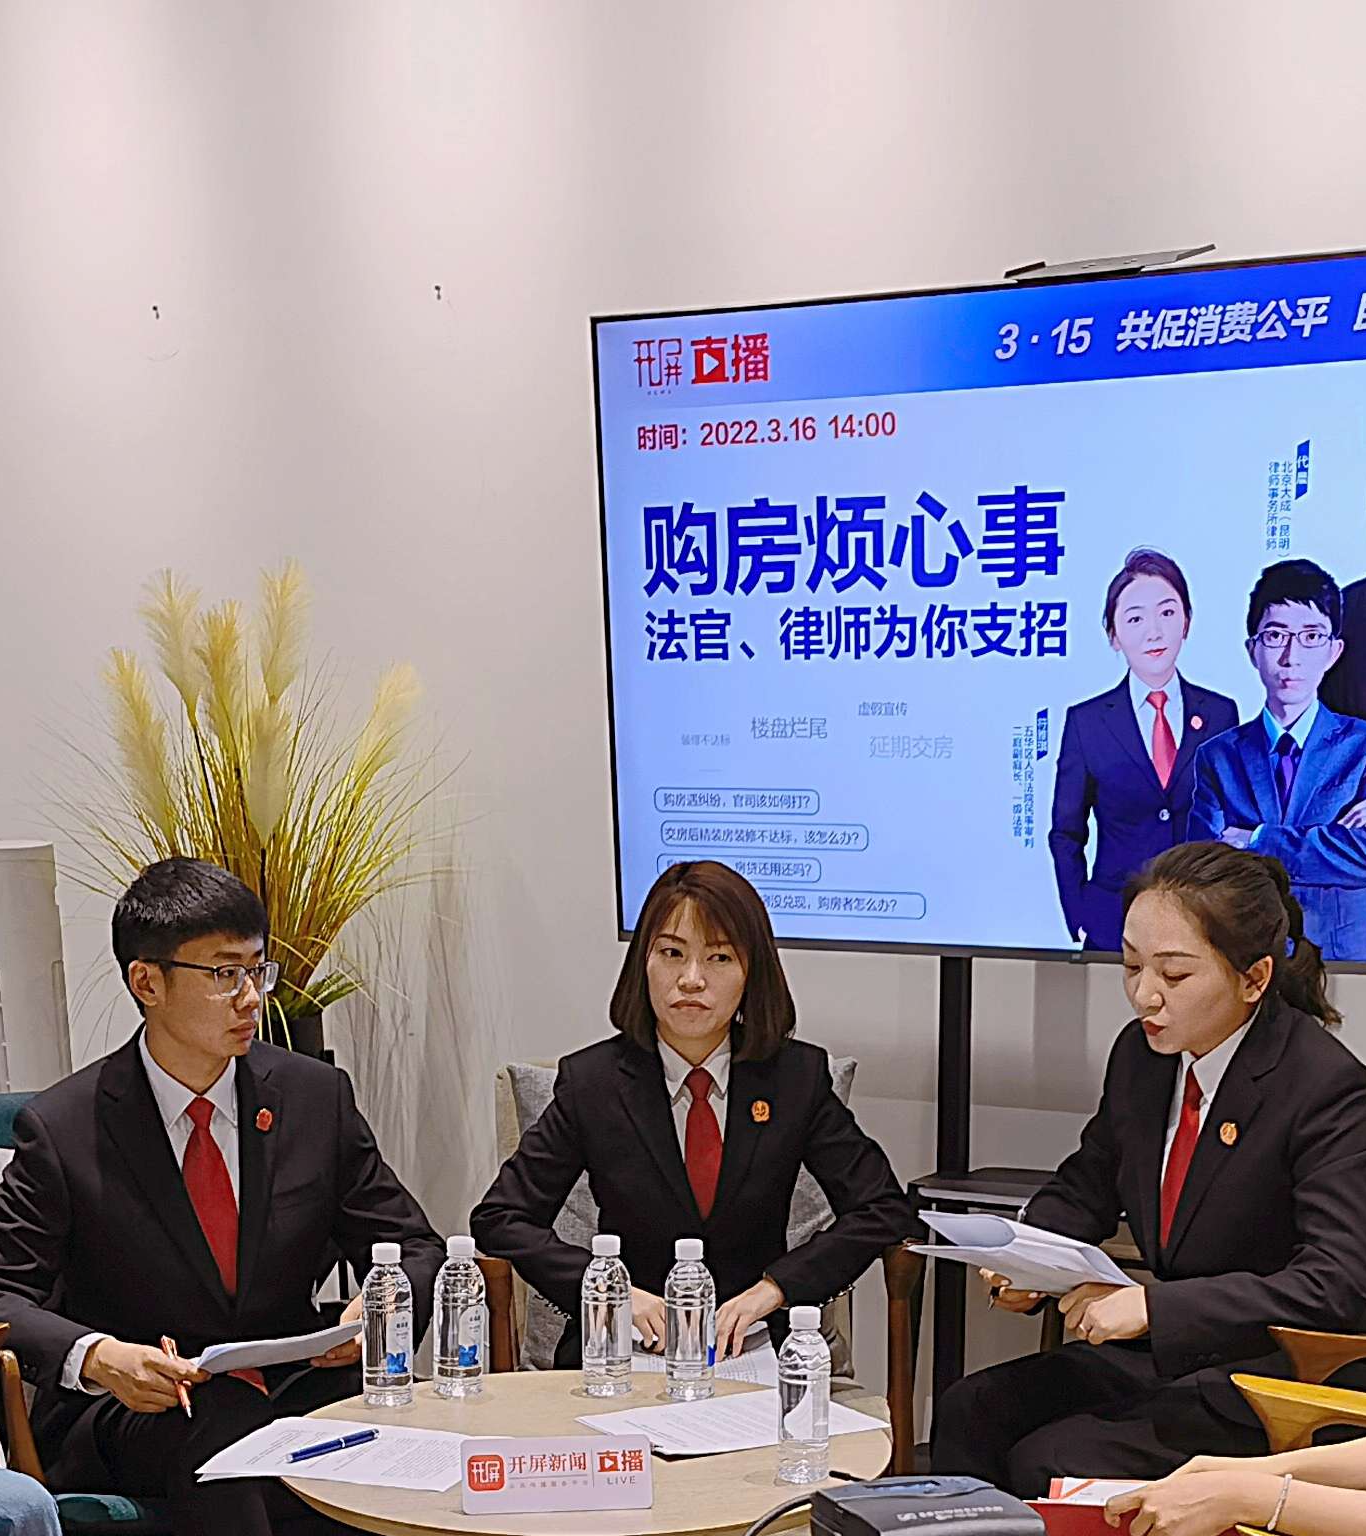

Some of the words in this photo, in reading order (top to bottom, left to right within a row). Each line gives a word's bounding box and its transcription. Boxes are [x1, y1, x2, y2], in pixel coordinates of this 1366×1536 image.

[1116, 295, 1331, 353] 共促消费公平
[691, 333, 769, 384] 直播
[700, 416, 817, 447] 2022.3.16
[828, 412, 896, 439] 14:00
[643, 485, 1066, 598] 购房烦心事
[645, 602, 1067, 661] 法官、律师为你支招
[751, 717, 828, 739] 楼盘烂尾
[869, 735, 954, 759] 延期交房
[508, 1452, 586, 1474] 开屏新闻
[596, 1450, 643, 1472] 直播
[607, 1475, 636, 1485] LIVE
